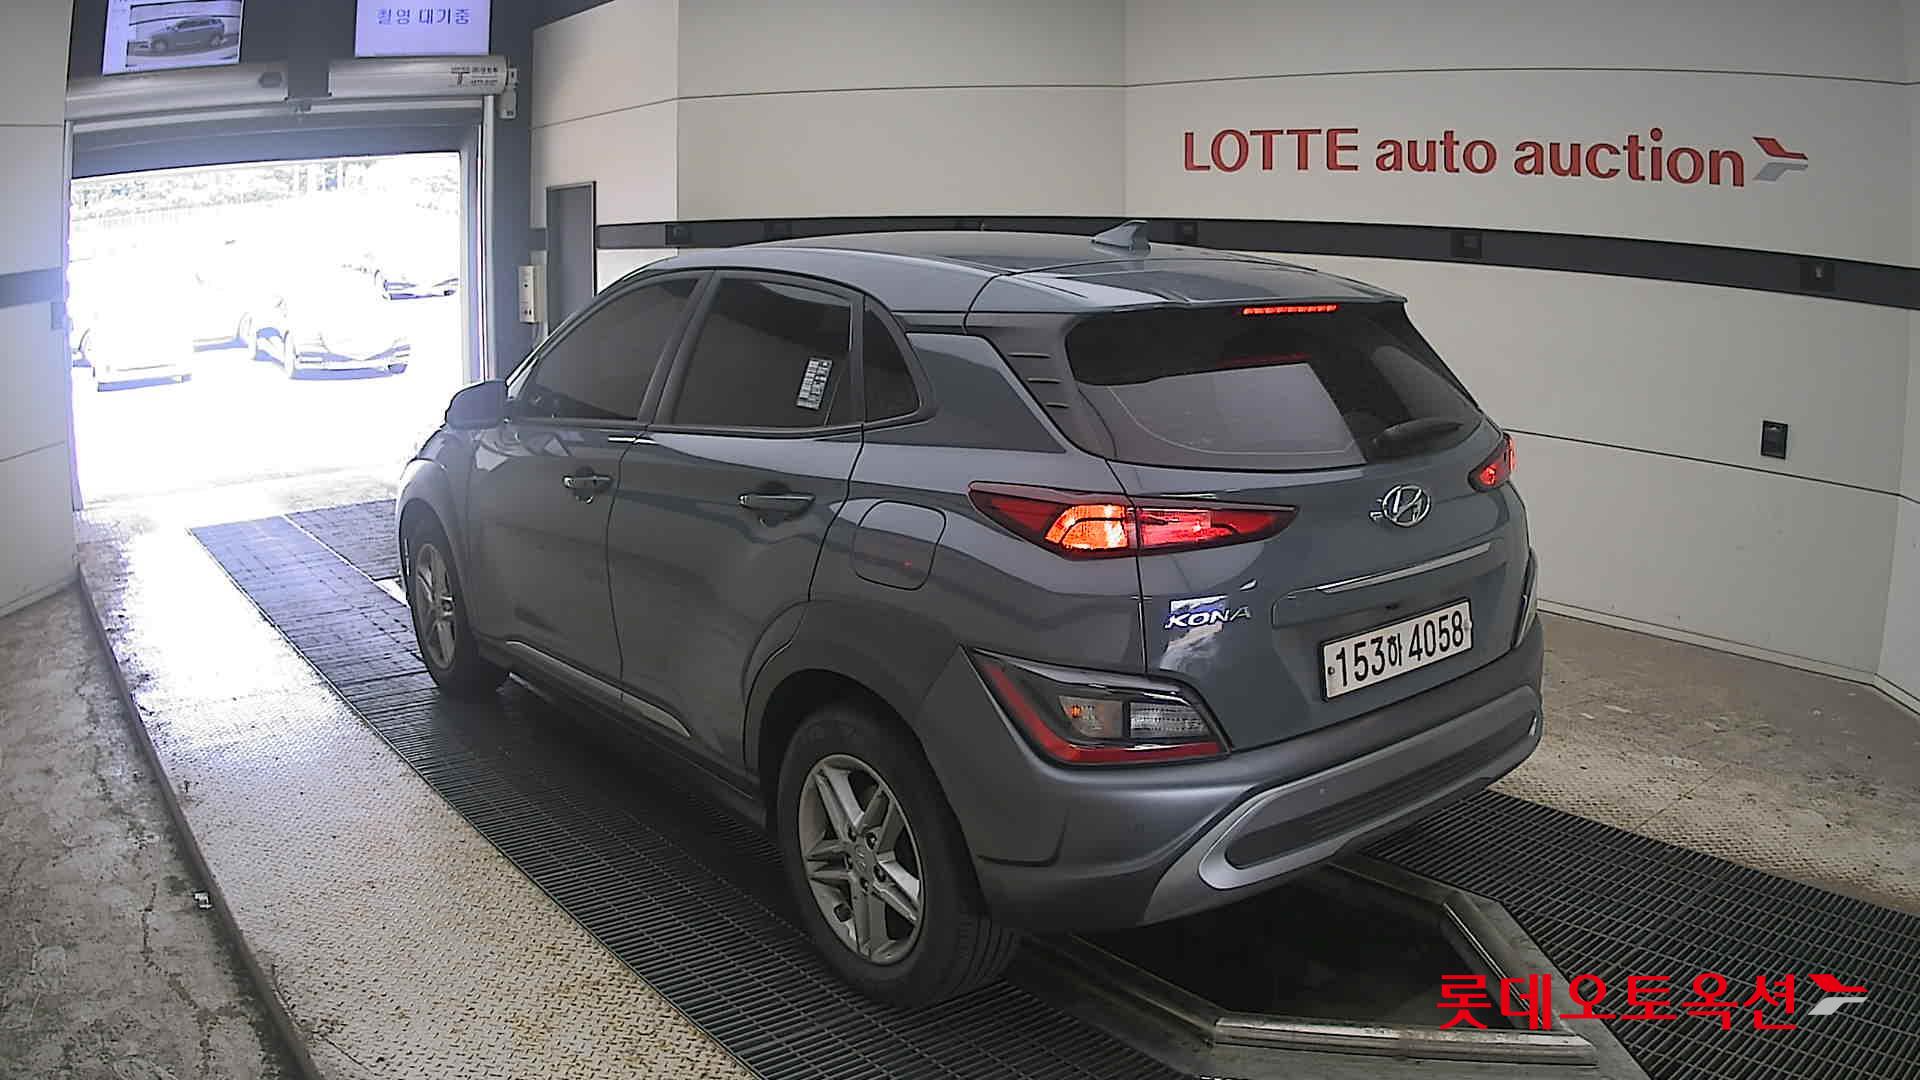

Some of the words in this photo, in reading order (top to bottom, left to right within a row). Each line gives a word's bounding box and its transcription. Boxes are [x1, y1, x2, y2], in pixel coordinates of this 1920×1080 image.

[419, 7, 470, 24] 대기중
[1185, 128, 1357, 174] LOTTE
[1377, 132, 1498, 174] auto
[1515, 128, 1744, 186] auction
[1165, 606, 1251, 629] KONA
